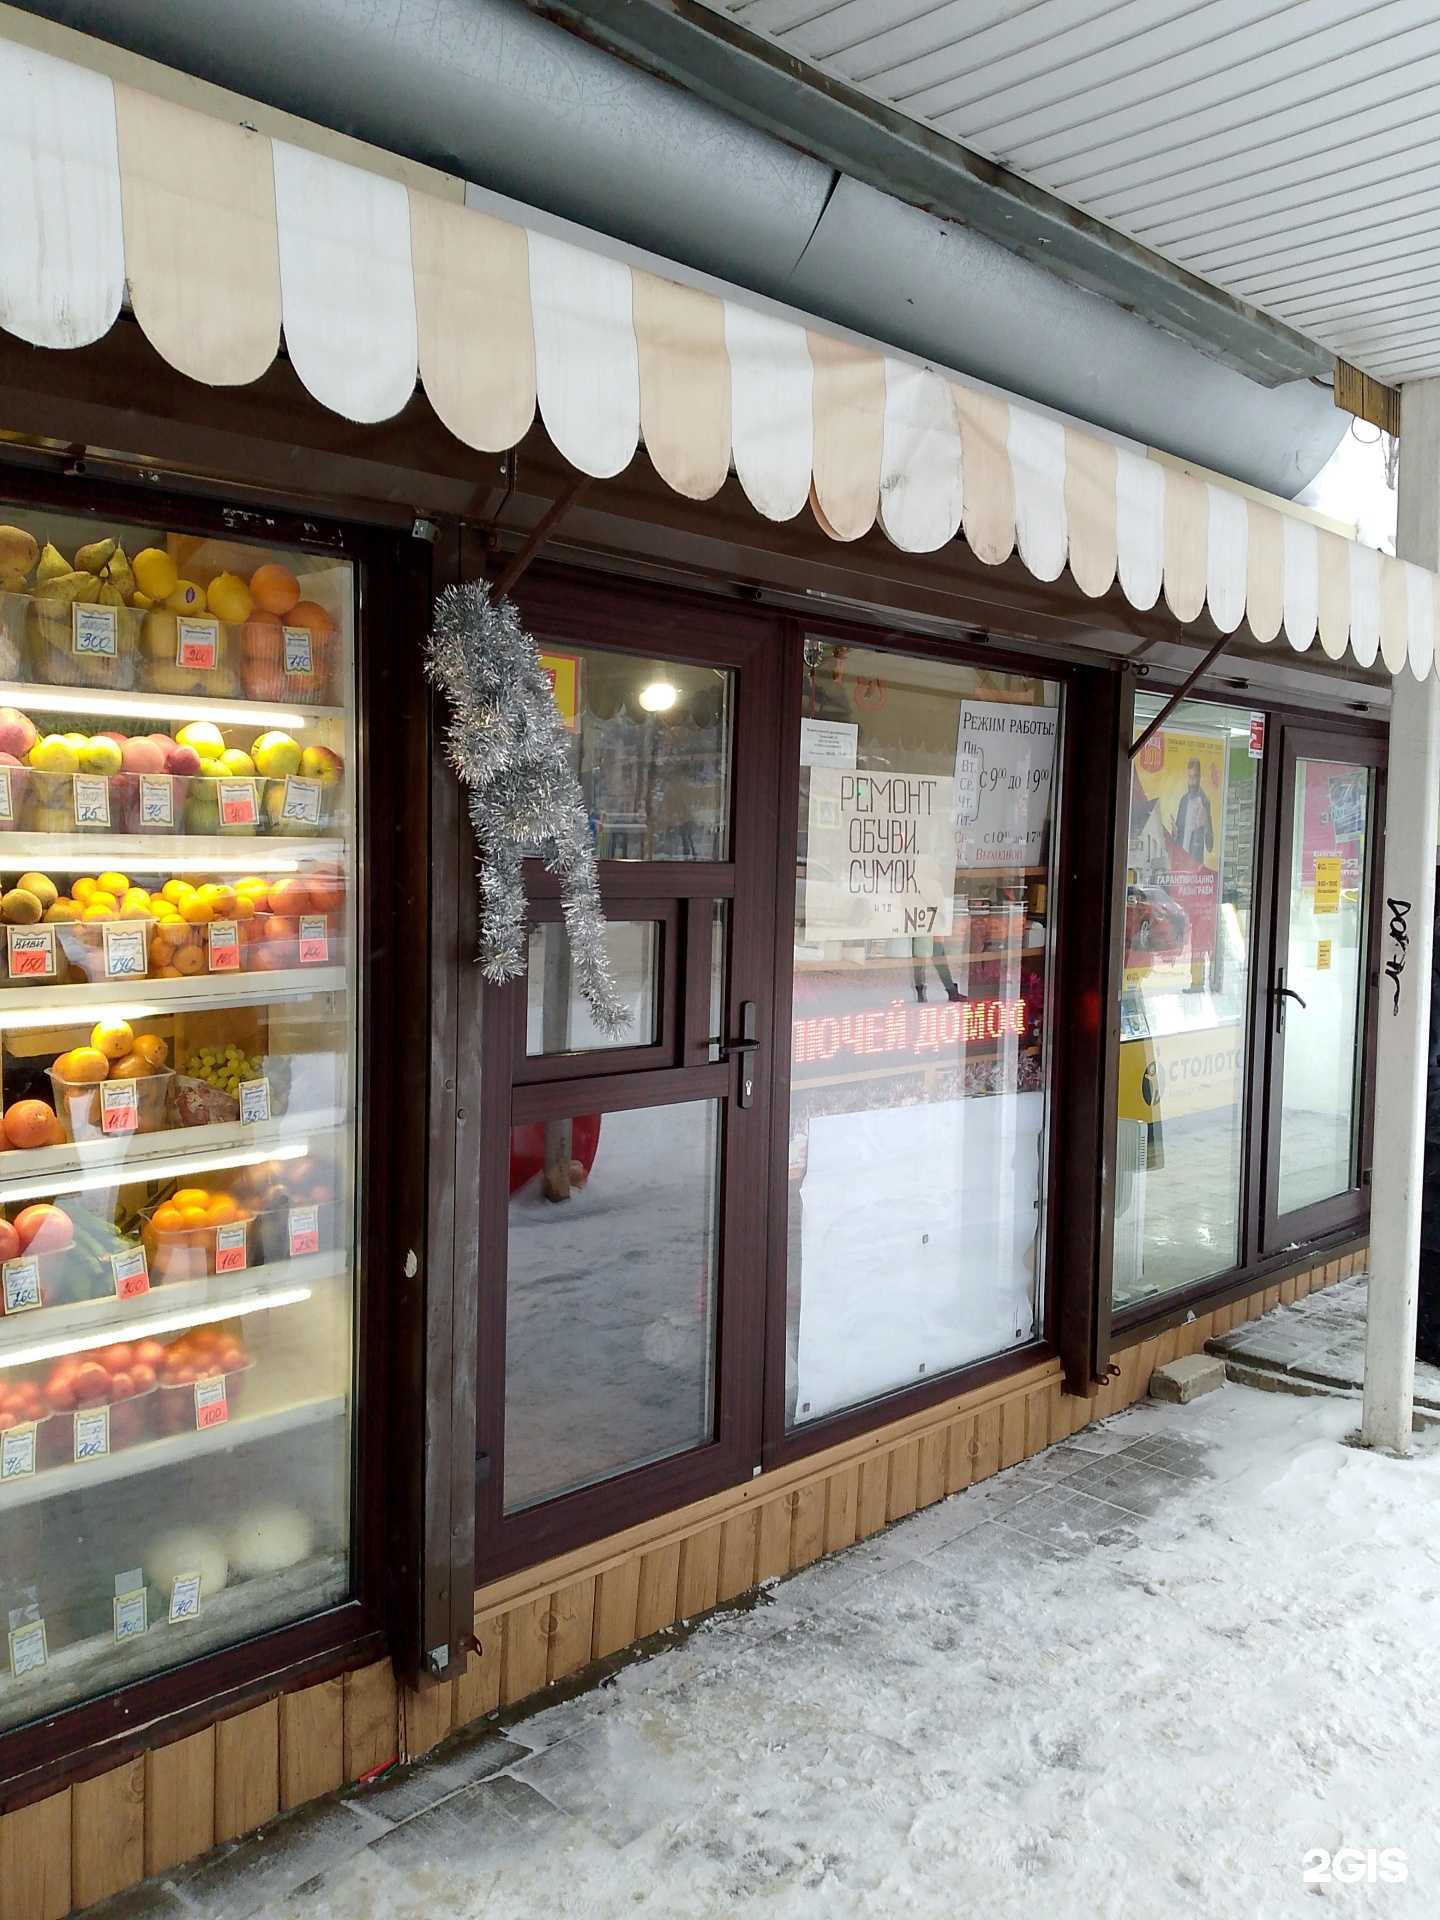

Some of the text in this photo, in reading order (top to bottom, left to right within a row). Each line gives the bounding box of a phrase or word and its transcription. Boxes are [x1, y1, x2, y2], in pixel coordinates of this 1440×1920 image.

[963, 711, 1056, 736] РЕЖИМ РАБОТЫ:
[840, 775, 937, 816] РЕМОНТ
[849, 817, 920, 855] ОБУВИ.
[849, 859, 921, 894] СУМОК.
